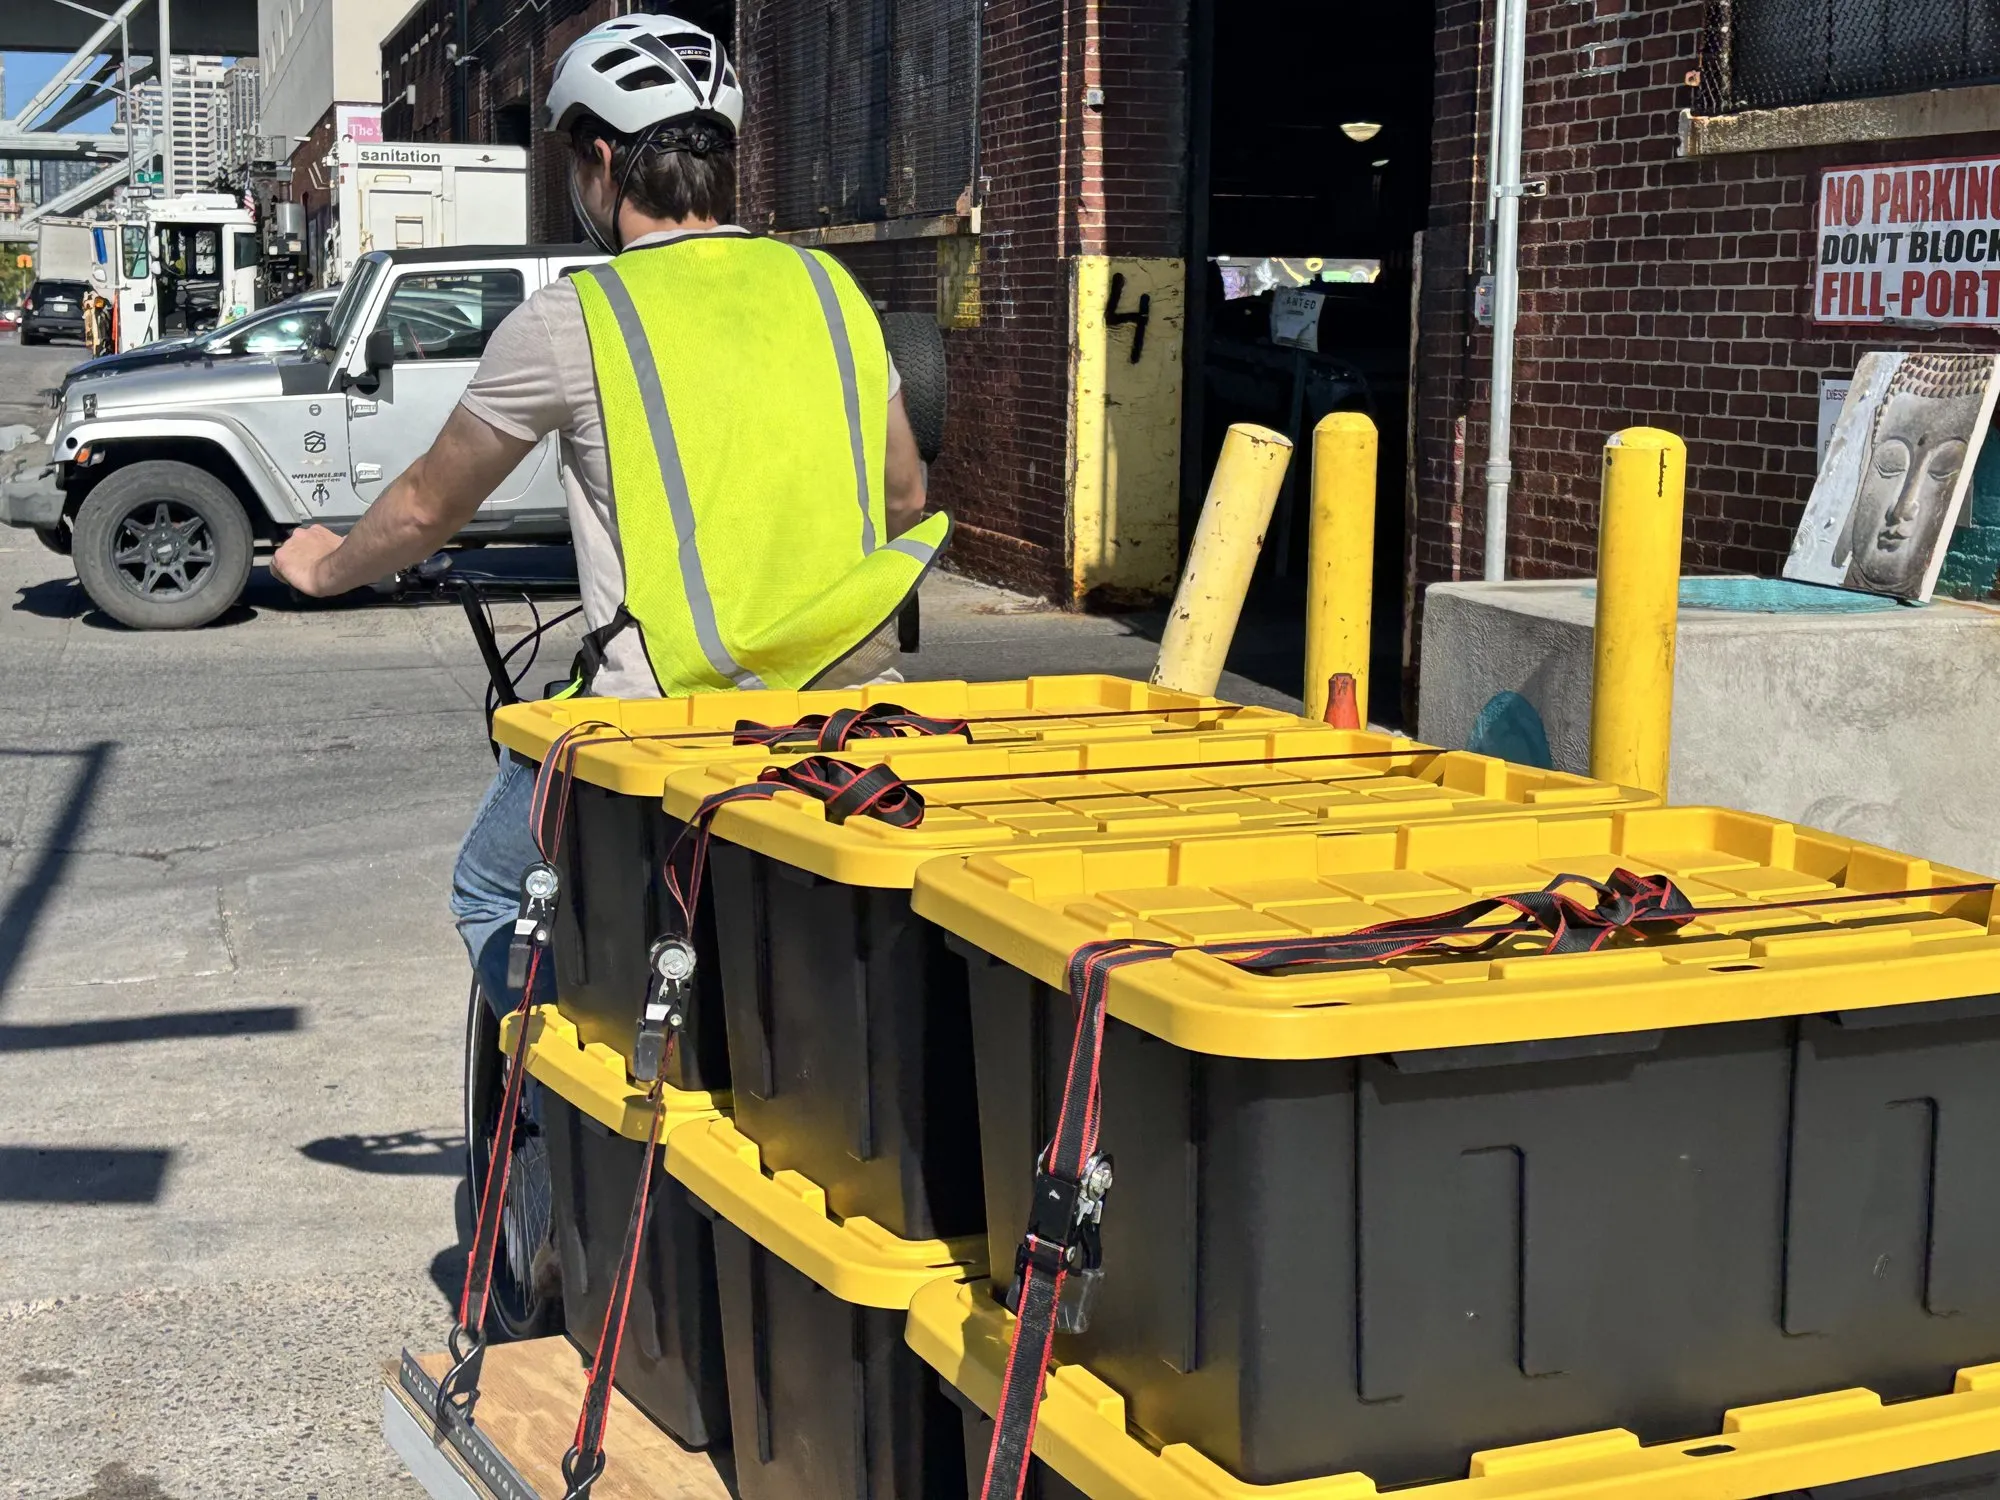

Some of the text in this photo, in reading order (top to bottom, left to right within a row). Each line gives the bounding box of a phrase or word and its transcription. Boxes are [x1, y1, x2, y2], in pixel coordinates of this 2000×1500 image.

[349, 124, 374, 136] The
[361, 149, 441, 163] sanitation
[1825, 174, 1865, 226] NO
[1821, 232, 1904, 265] DON'T
[1284, 296, 1316, 310] ANTED
[1821, 270, 2000, 318] FILL-PORT
[1105, 273, 1150, 364] 4
